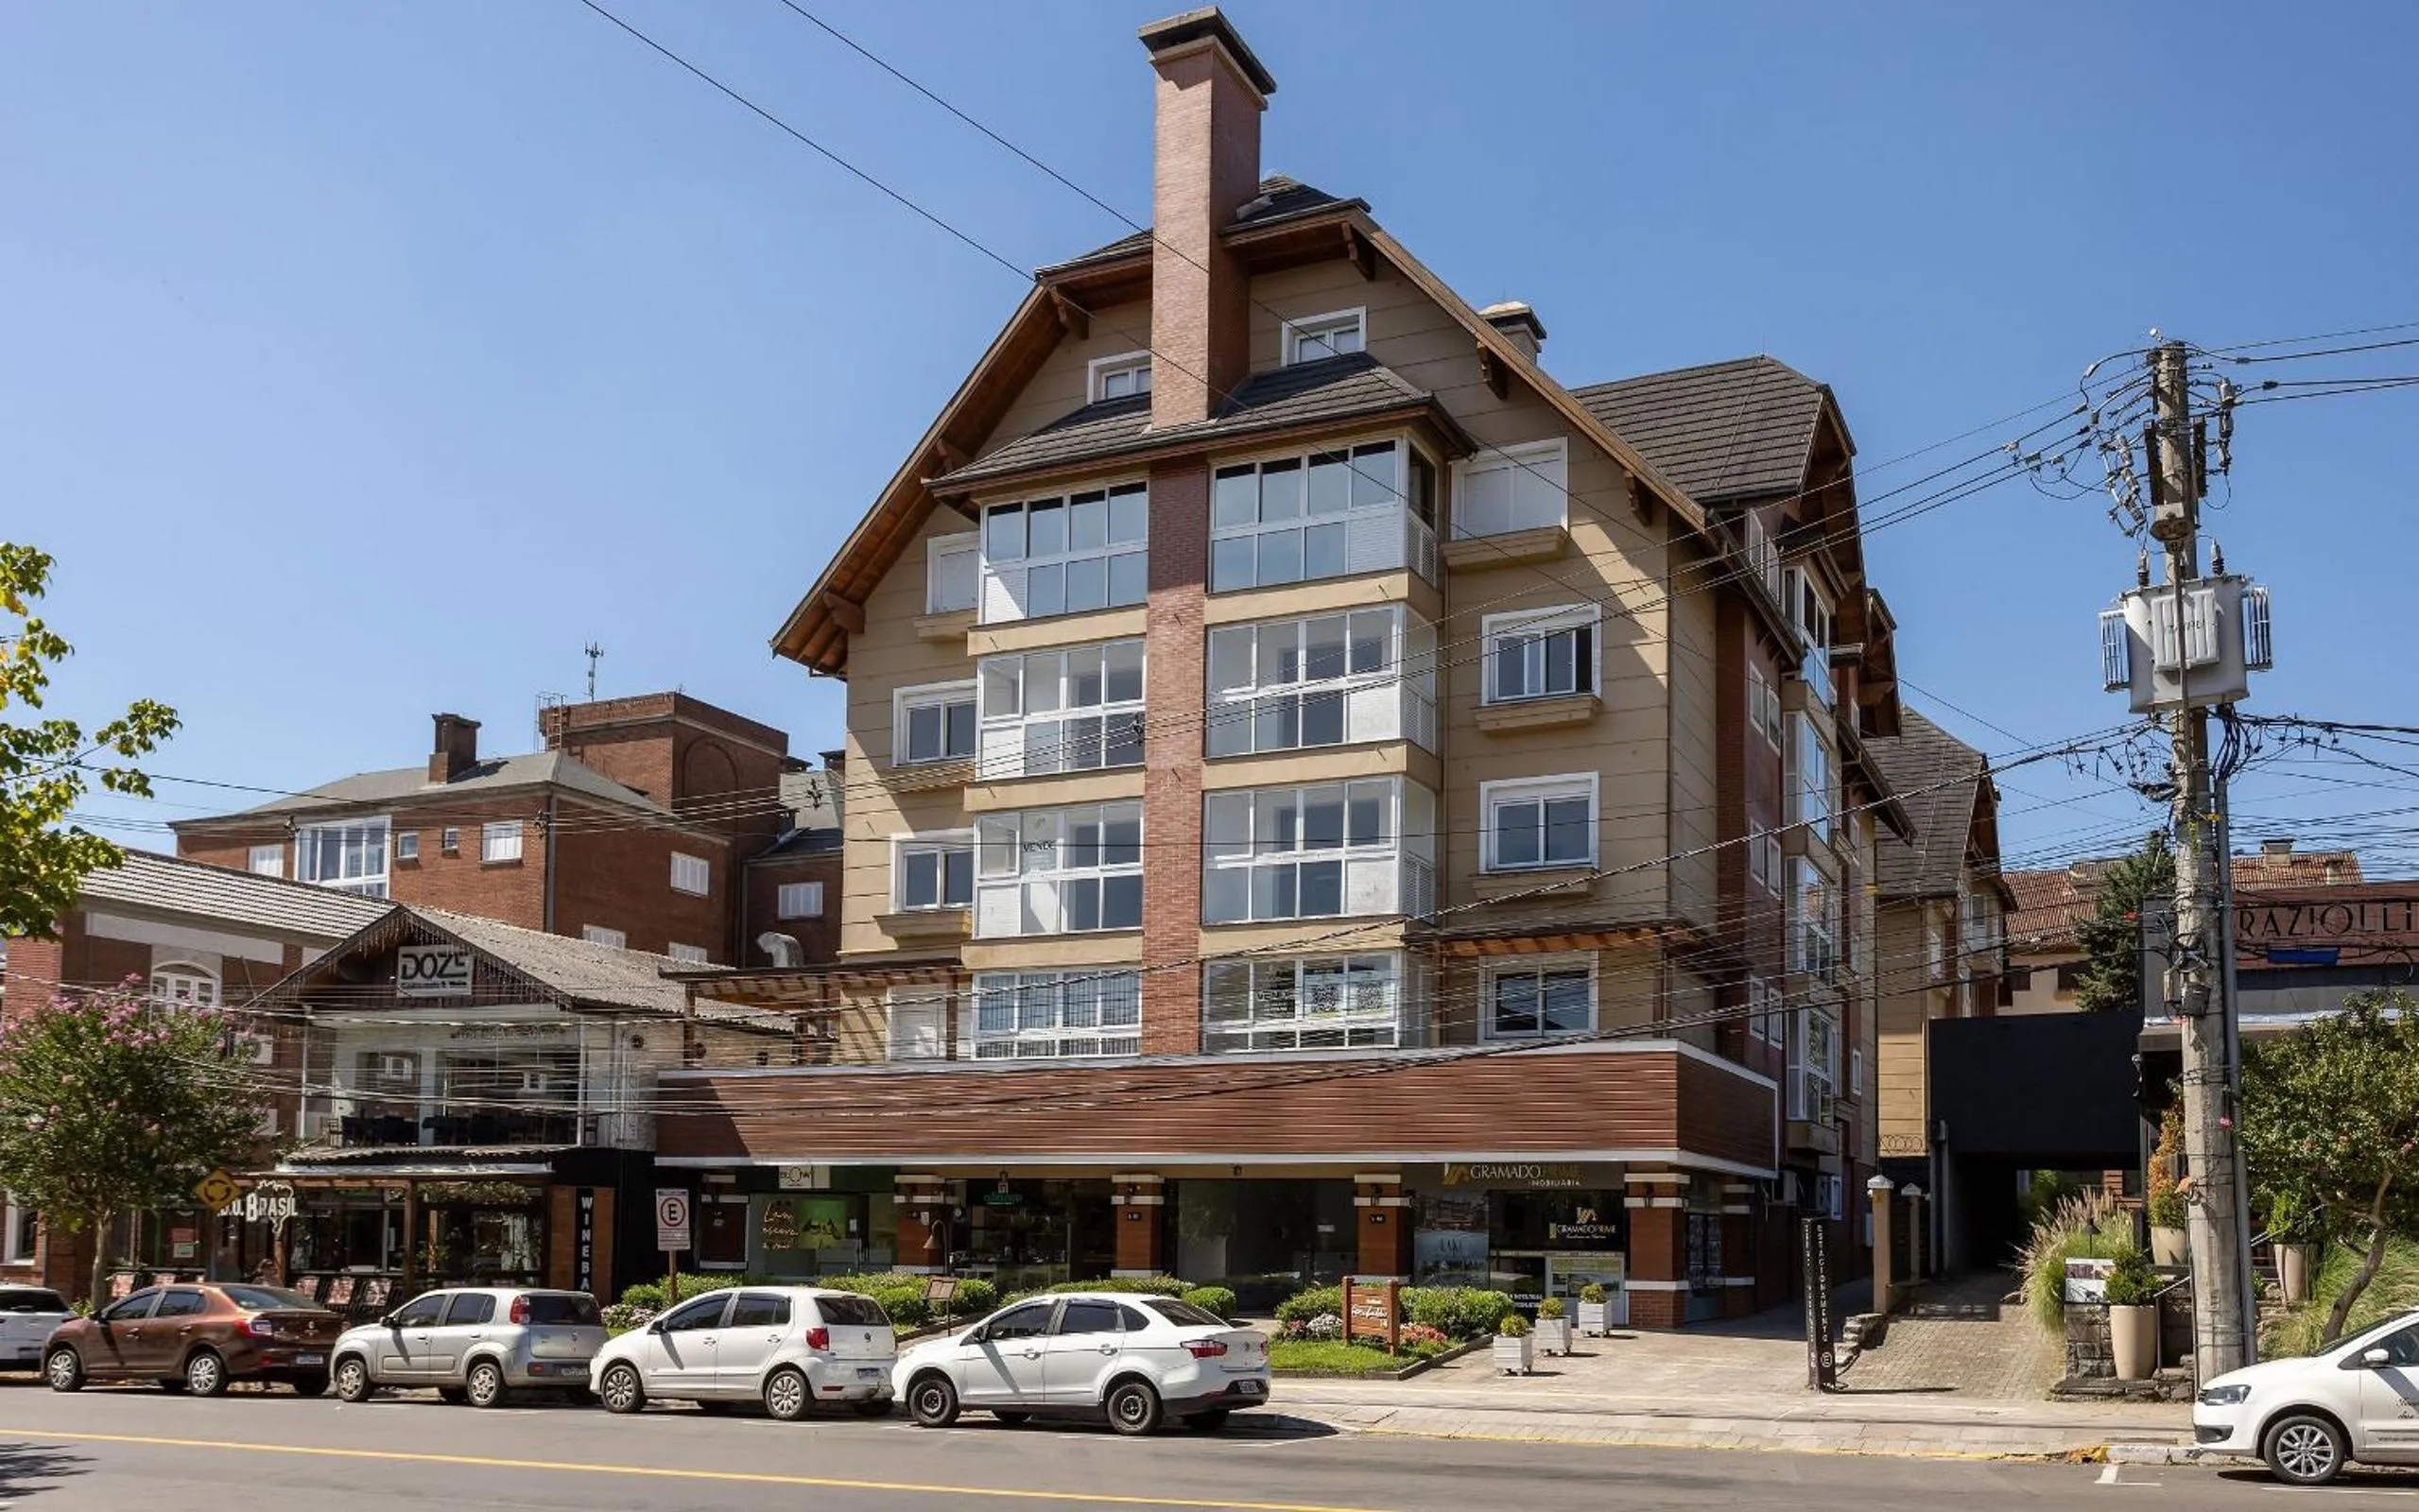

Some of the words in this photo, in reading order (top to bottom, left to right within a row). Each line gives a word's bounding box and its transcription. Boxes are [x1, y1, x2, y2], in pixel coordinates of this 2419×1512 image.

[2238, 902, 2411, 938] RAZIOLLI
[668, 1203, 678, 1221] E
[580, 1196, 593, 1291] WINEBA
